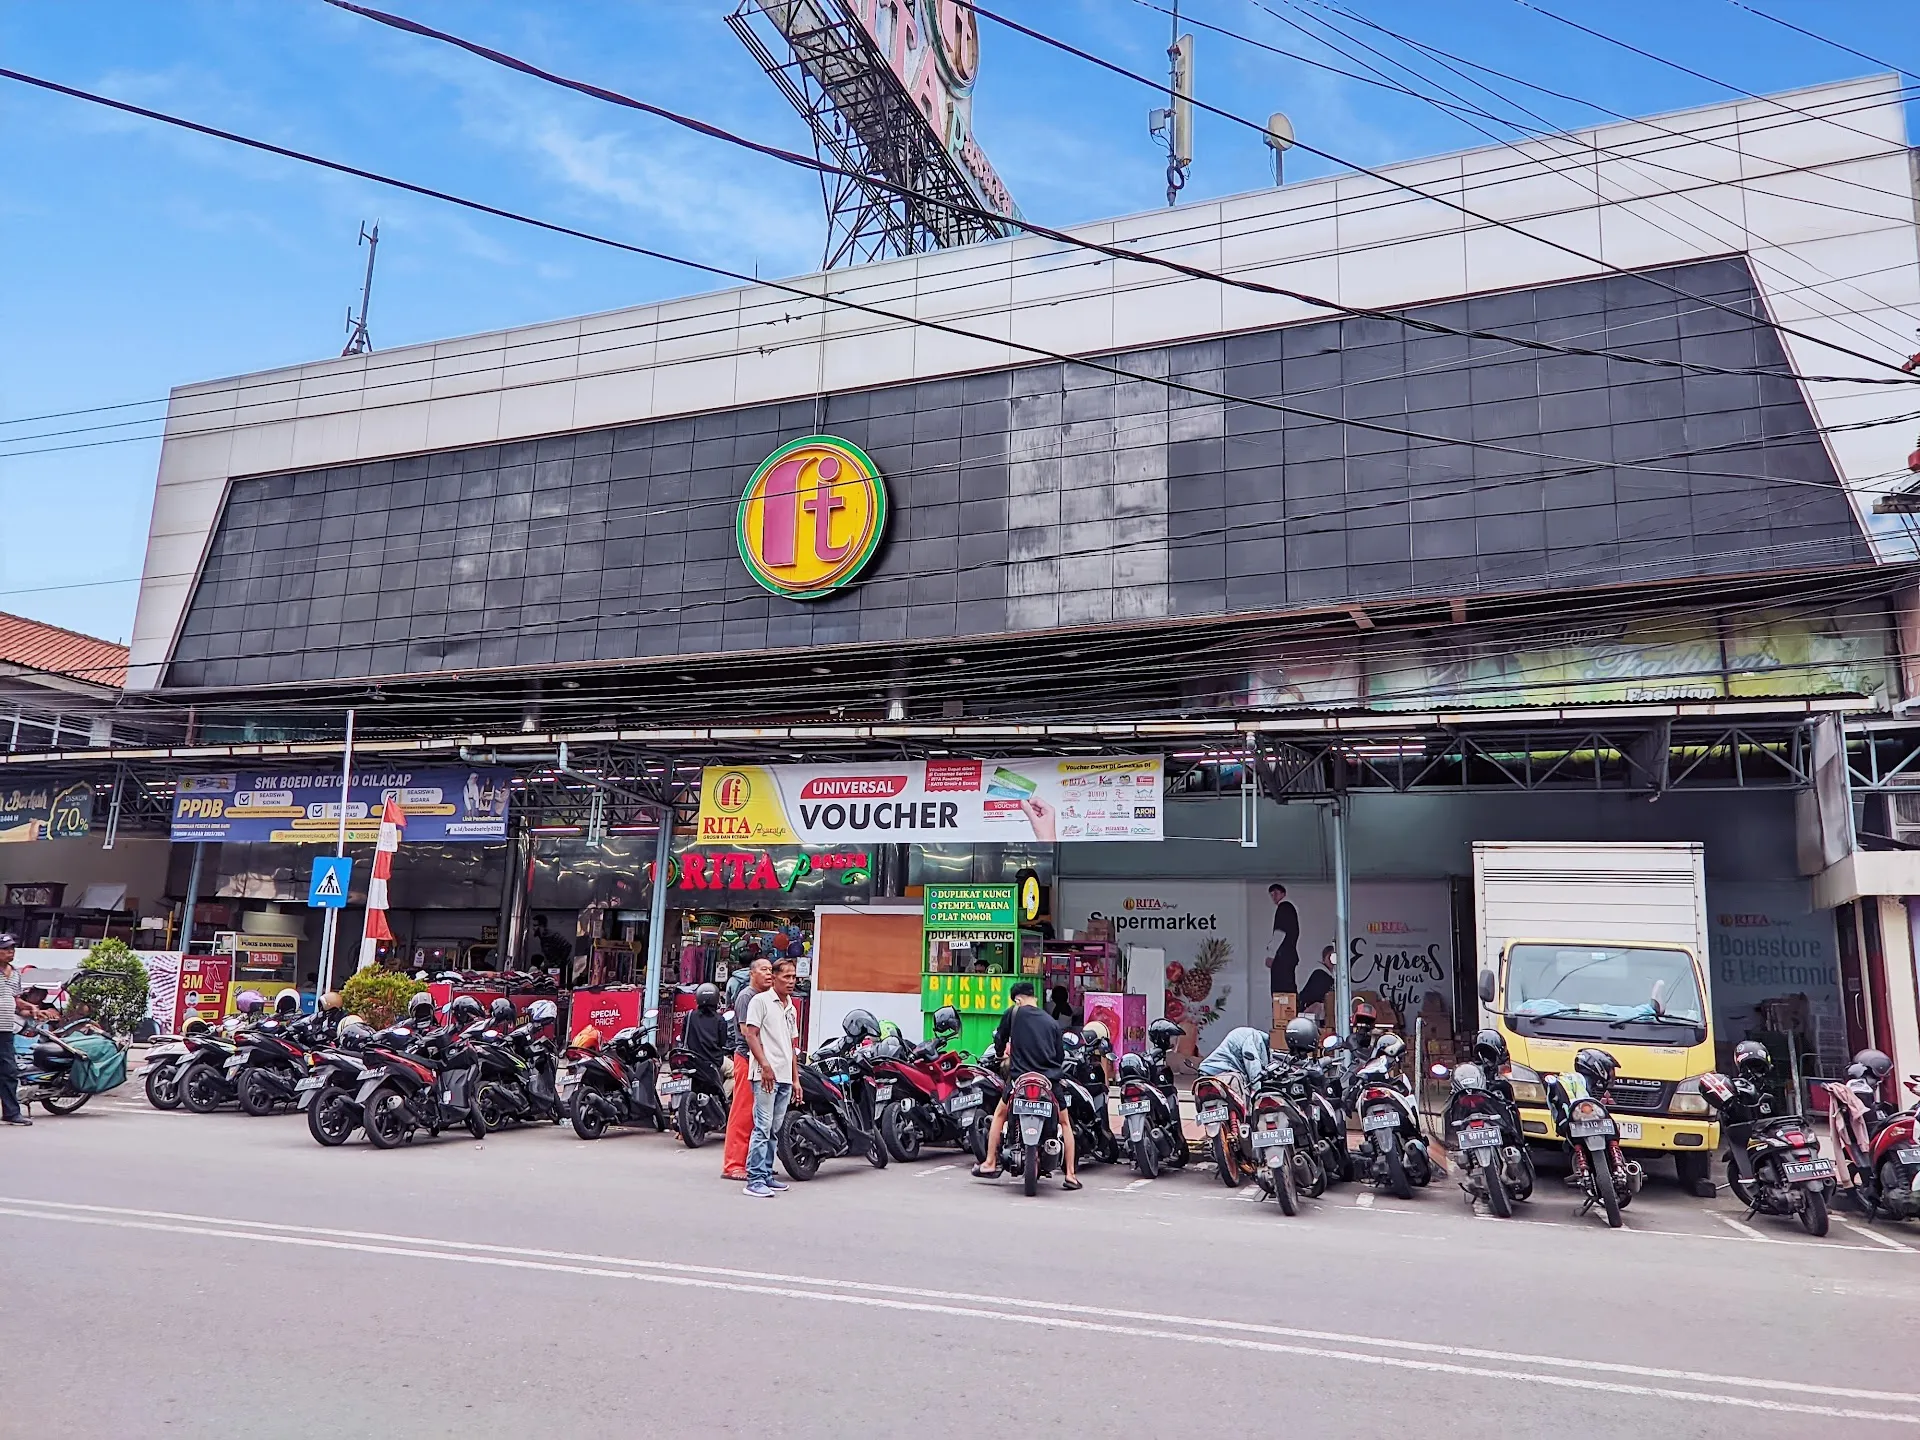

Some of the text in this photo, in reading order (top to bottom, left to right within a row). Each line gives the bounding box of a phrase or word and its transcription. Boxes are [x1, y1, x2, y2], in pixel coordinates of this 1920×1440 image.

[1624, 686, 1717, 701] Fashion
[255, 773, 412, 789] SMK BOEDI OETOO CILACAP
[812, 780, 895, 795] UNIVERSAL
[177, 798, 224, 818] PPDB
[799, 802, 959, 830] VOUCHER
[703, 816, 751, 834] RITA
[679, 852, 781, 891] RITA
[937, 889, 1011, 899] DUPLIKAT KUNCI
[937, 901, 1009, 910] STEMPEL WARNA
[1135, 898, 1162, 908] RITA
[937, 913, 992, 921] PLAT NOMOR
[931, 931, 981, 940] DUPLIKAT
[182, 974, 204, 989] 3M
[929, 975, 1003, 992] BIKIN
[1397, 973, 1425, 988] your
[590, 1009, 621, 1019] SPECIAL
[594, 1018, 615, 1026] PRICE
[1626, 1079, 1661, 1087] FUSO
[1627, 1123, 1639, 1134] BR
[1787, 1166, 1795, 1174] R
[1796, 1164, 1813, 1173] 5202
